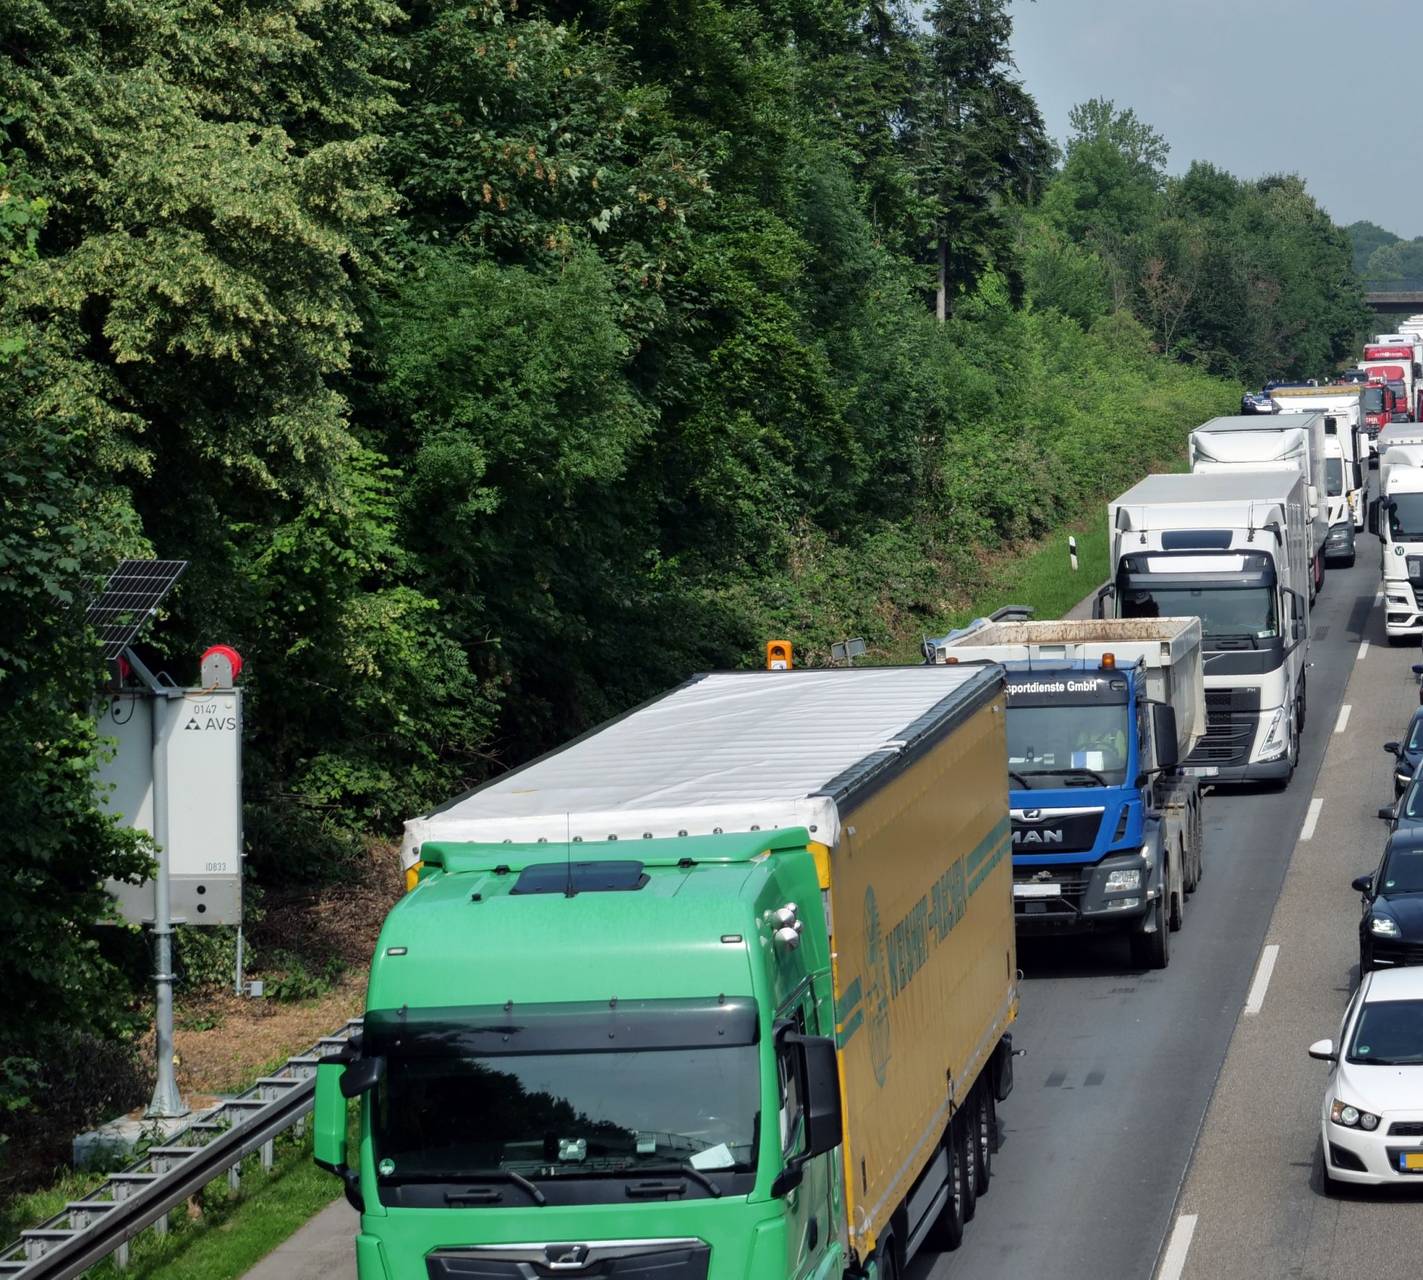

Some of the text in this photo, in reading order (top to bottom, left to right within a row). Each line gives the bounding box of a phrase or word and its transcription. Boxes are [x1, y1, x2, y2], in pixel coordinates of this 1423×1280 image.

[1067, 680, 1097, 692] GmbH
[194, 704, 217, 714] 0147
[205, 716, 236, 730] AVS
